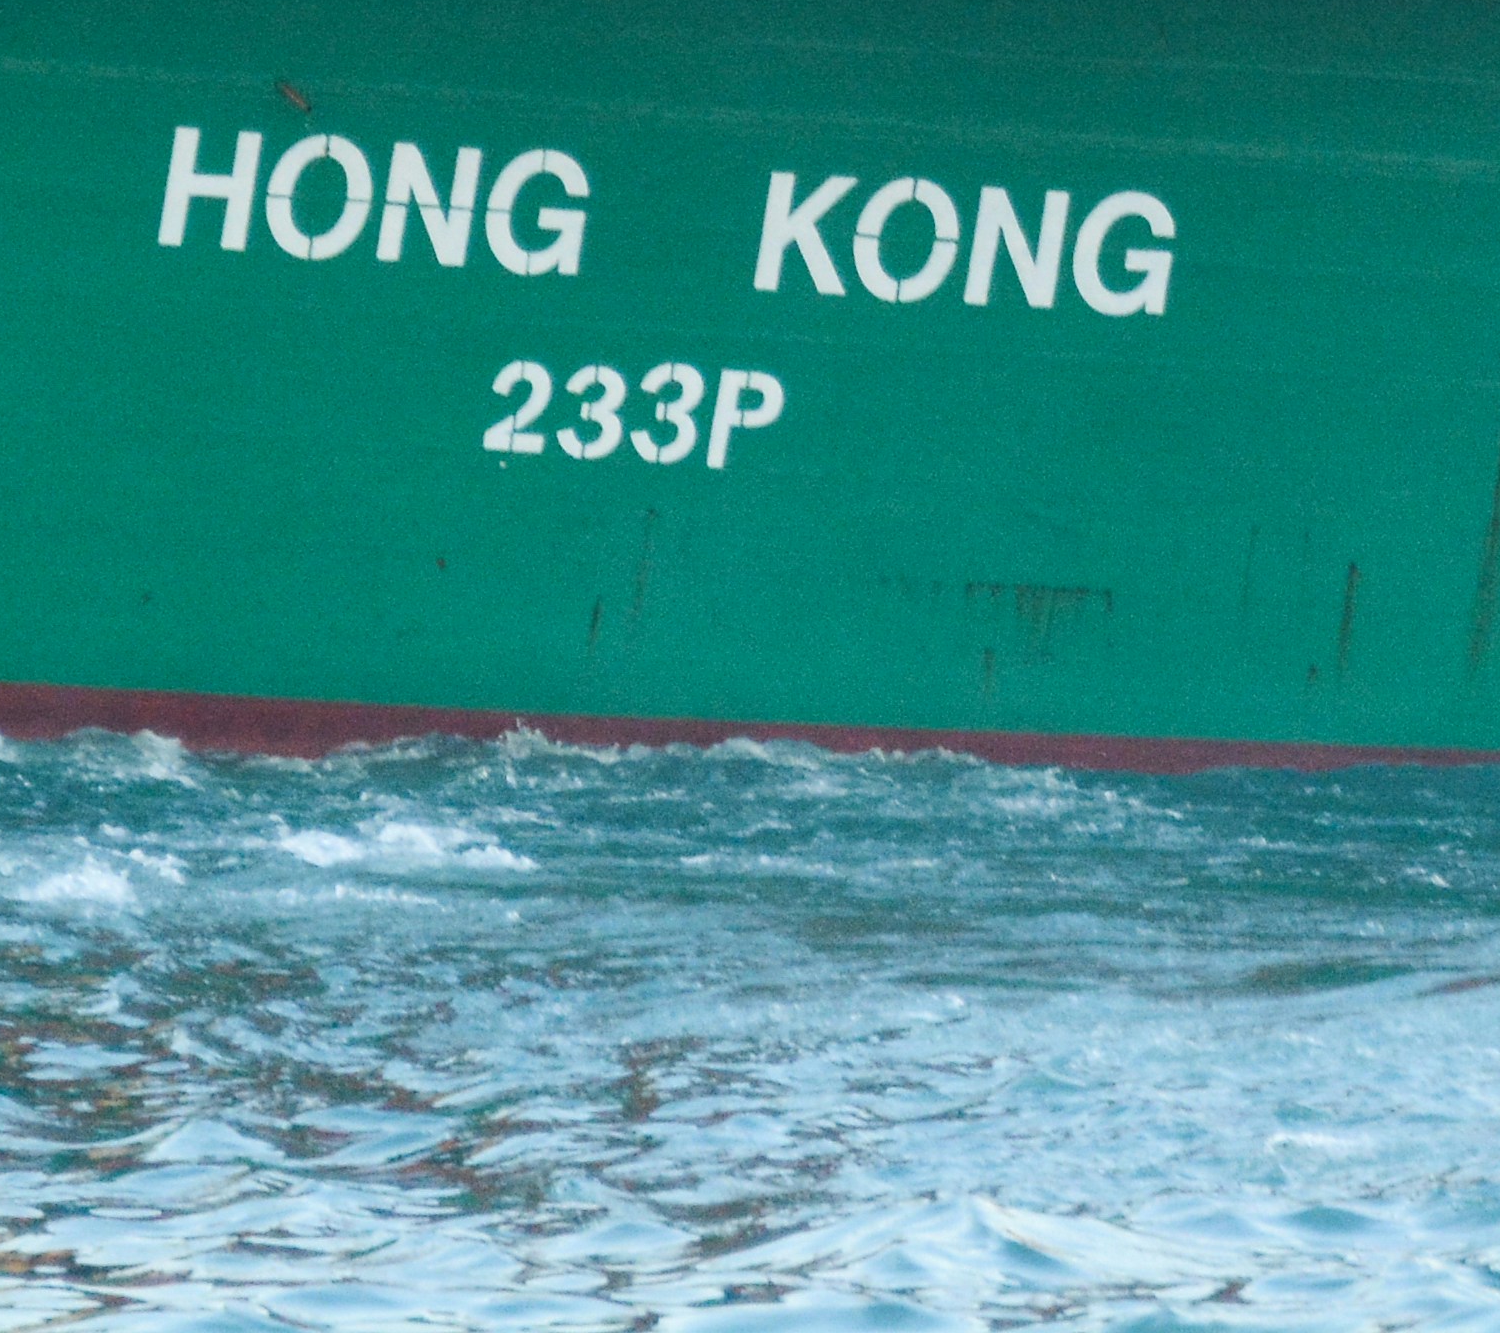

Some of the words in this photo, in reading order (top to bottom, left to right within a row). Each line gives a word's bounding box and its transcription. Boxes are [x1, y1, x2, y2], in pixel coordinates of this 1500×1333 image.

[157, 125, 591, 277] HONG
[752, 170, 1177, 317] KONG
[482, 360, 786, 469] 233P
